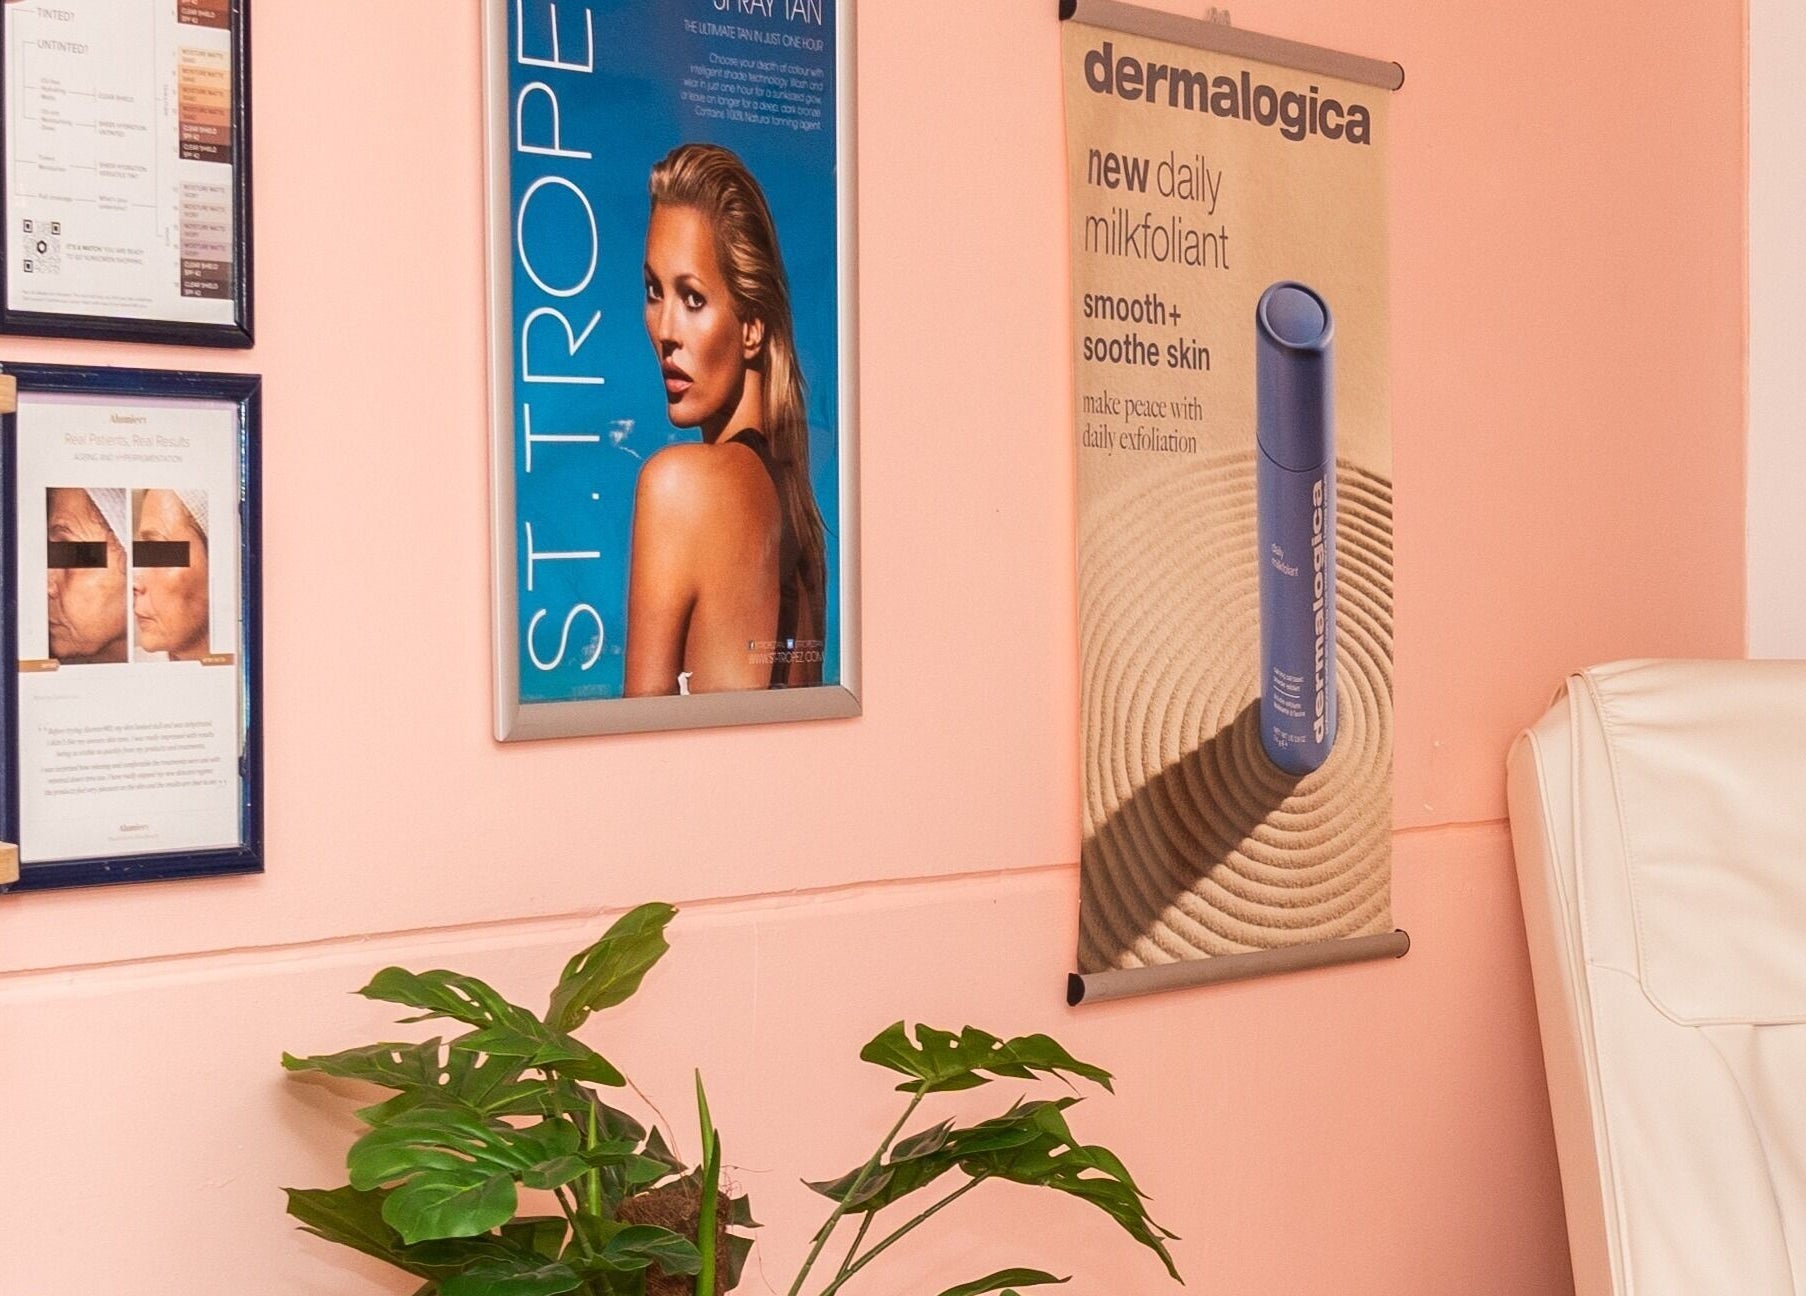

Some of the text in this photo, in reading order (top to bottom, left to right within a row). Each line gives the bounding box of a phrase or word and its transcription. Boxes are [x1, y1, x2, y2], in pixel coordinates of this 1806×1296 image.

[37, 7, 75, 21] TINTED?
[785, 0, 822, 26] TAN
[37, 39, 89, 55] UNTINTED?
[684, 19, 825, 52] THE ULTIMATE TAN IN JUST ONE HOUR
[709, 52, 738, 66] Choose
[740, 58, 755, 69] your
[720, 84, 736, 94] one
[736, 85, 754, 96] hour
[1084, 41, 1371, 146] dermalogica
[1088, 148, 1222, 216] new daily
[1084, 206, 1230, 270] milkfoliant
[1083, 332, 1211, 371] soothe skin
[1083, 389, 1203, 424] make peace with
[65, 432, 87, 446] Real
[132, 434, 153, 448] Real
[155, 435, 190, 448] Results
[1082, 422, 1197, 457] daily exfoliation
[1311, 479, 1325, 744] dermalogica
